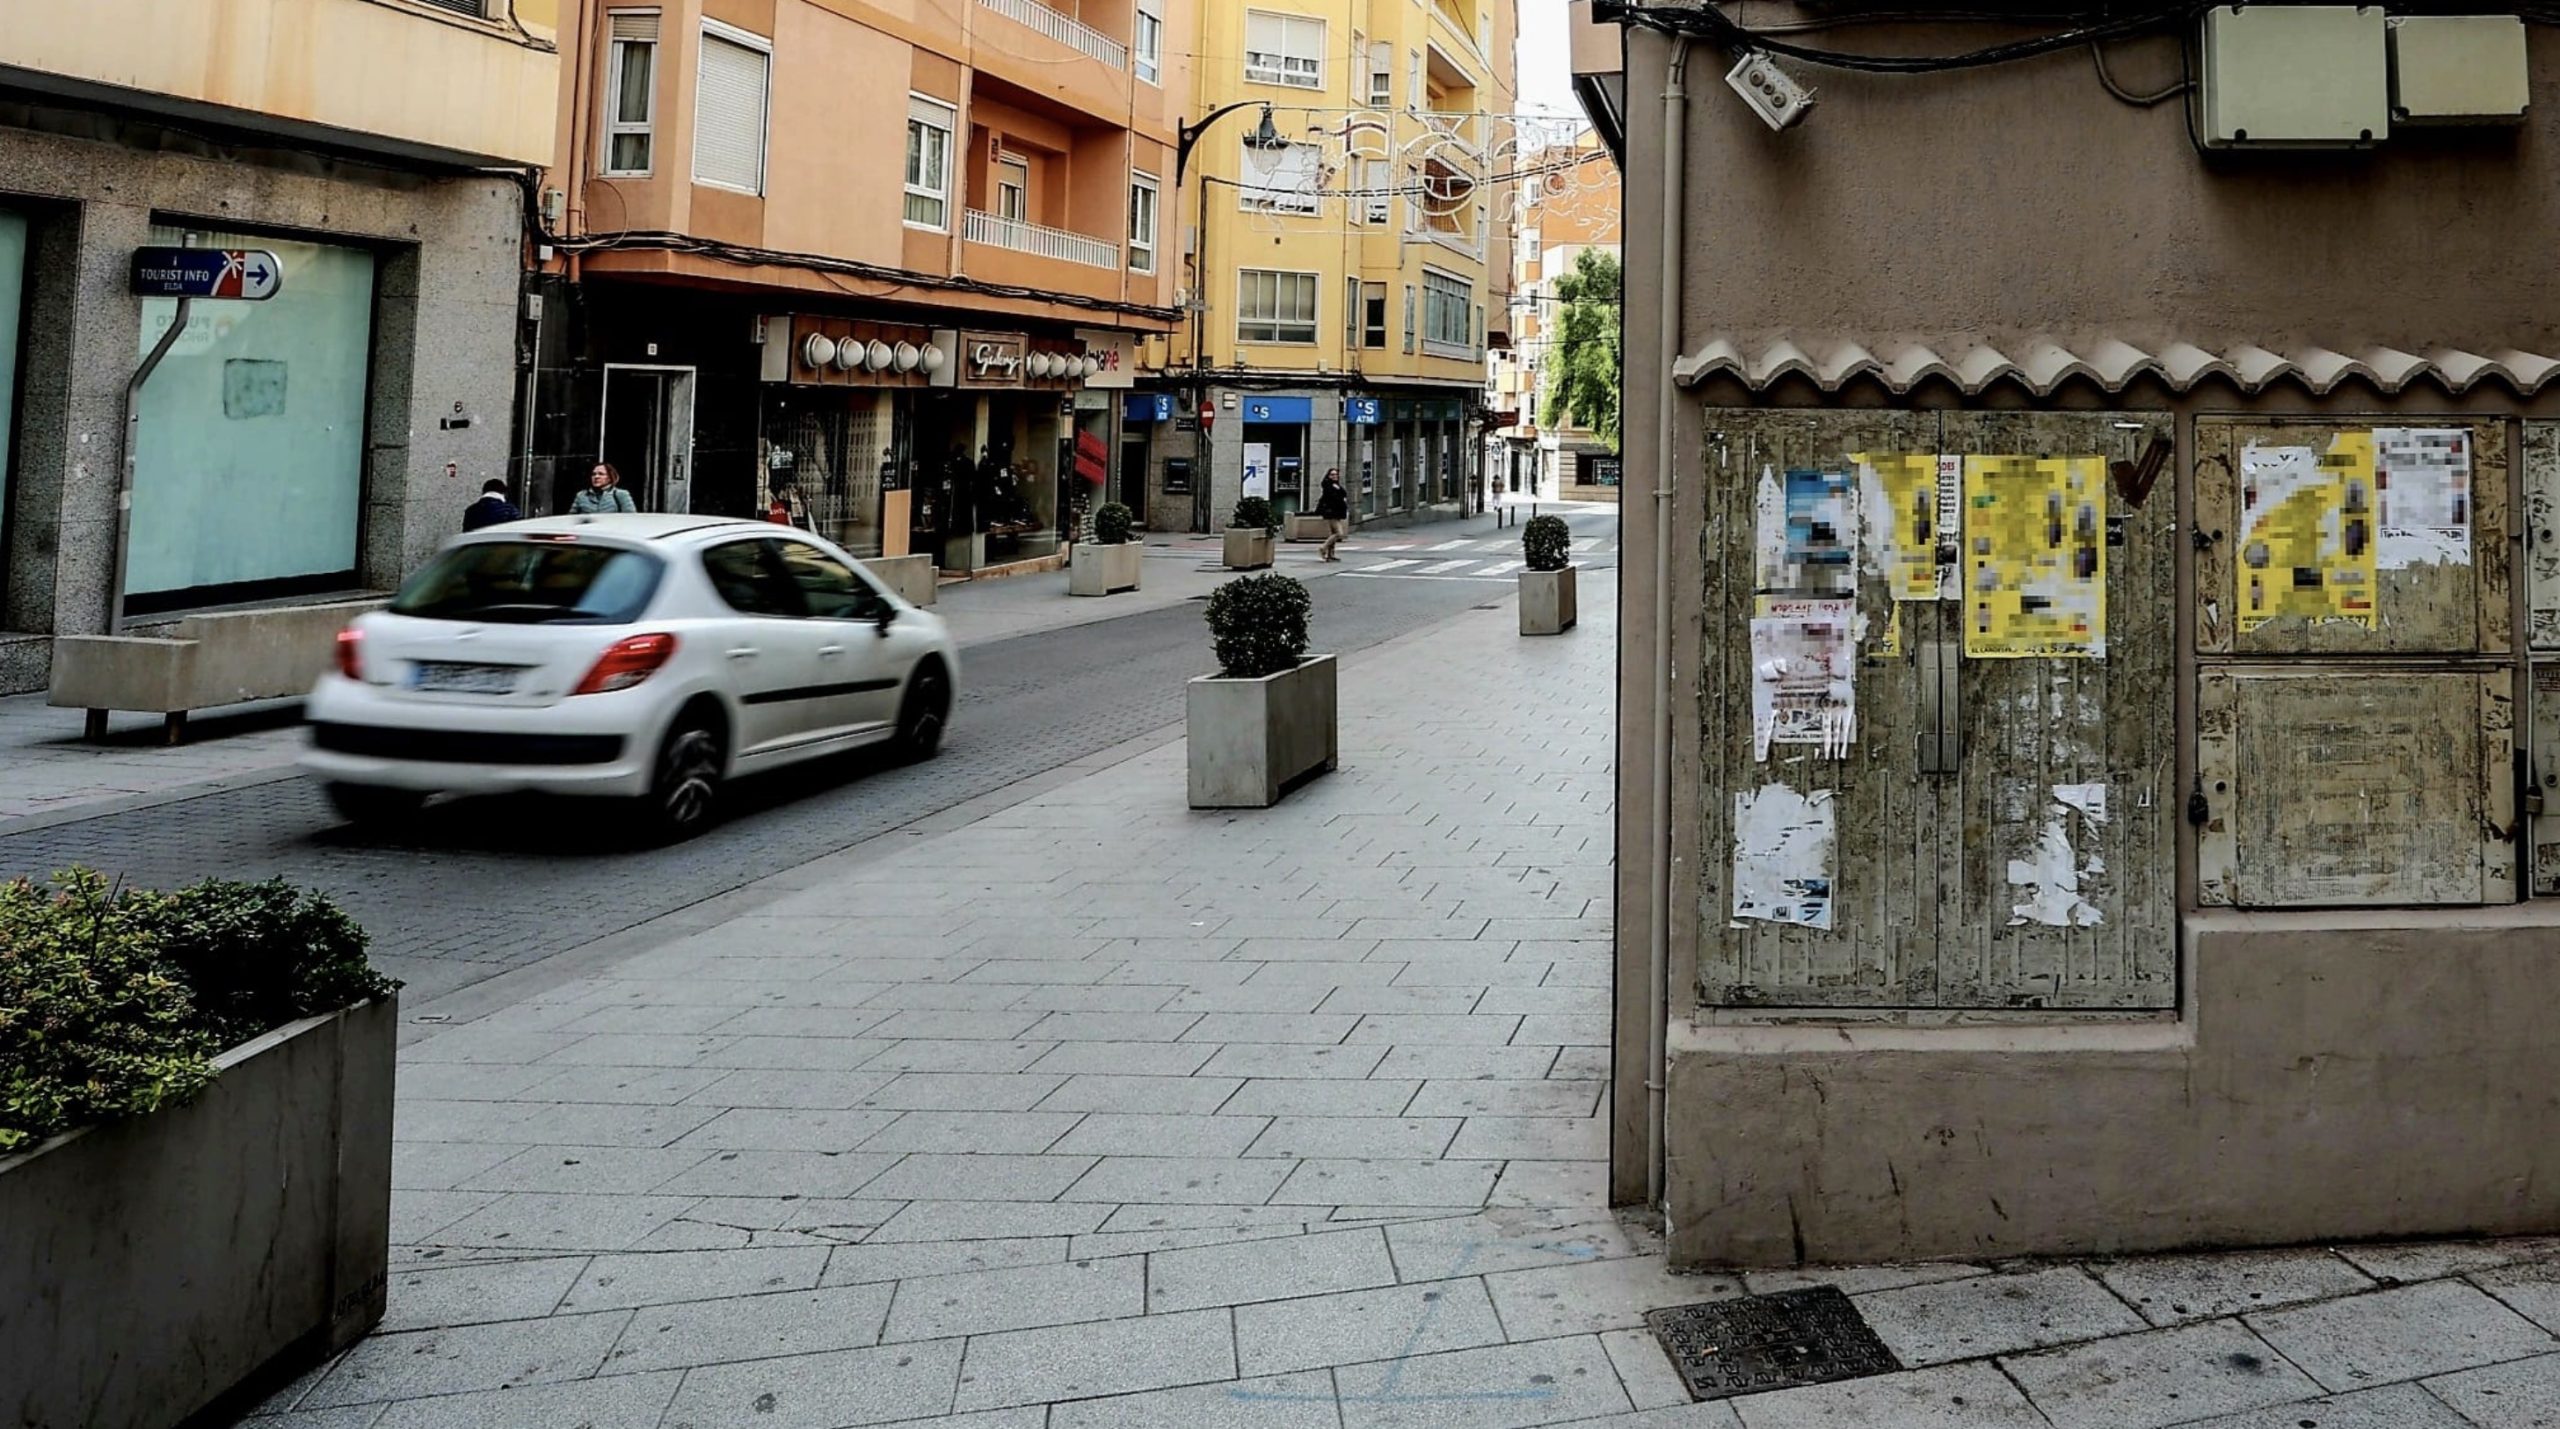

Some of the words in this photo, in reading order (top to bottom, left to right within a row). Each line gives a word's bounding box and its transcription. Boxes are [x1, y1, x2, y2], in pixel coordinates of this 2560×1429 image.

[140, 268, 183, 282] TOURIST
[184, 269, 210, 283] INFO
[1356, 415, 1375, 424] ATM
